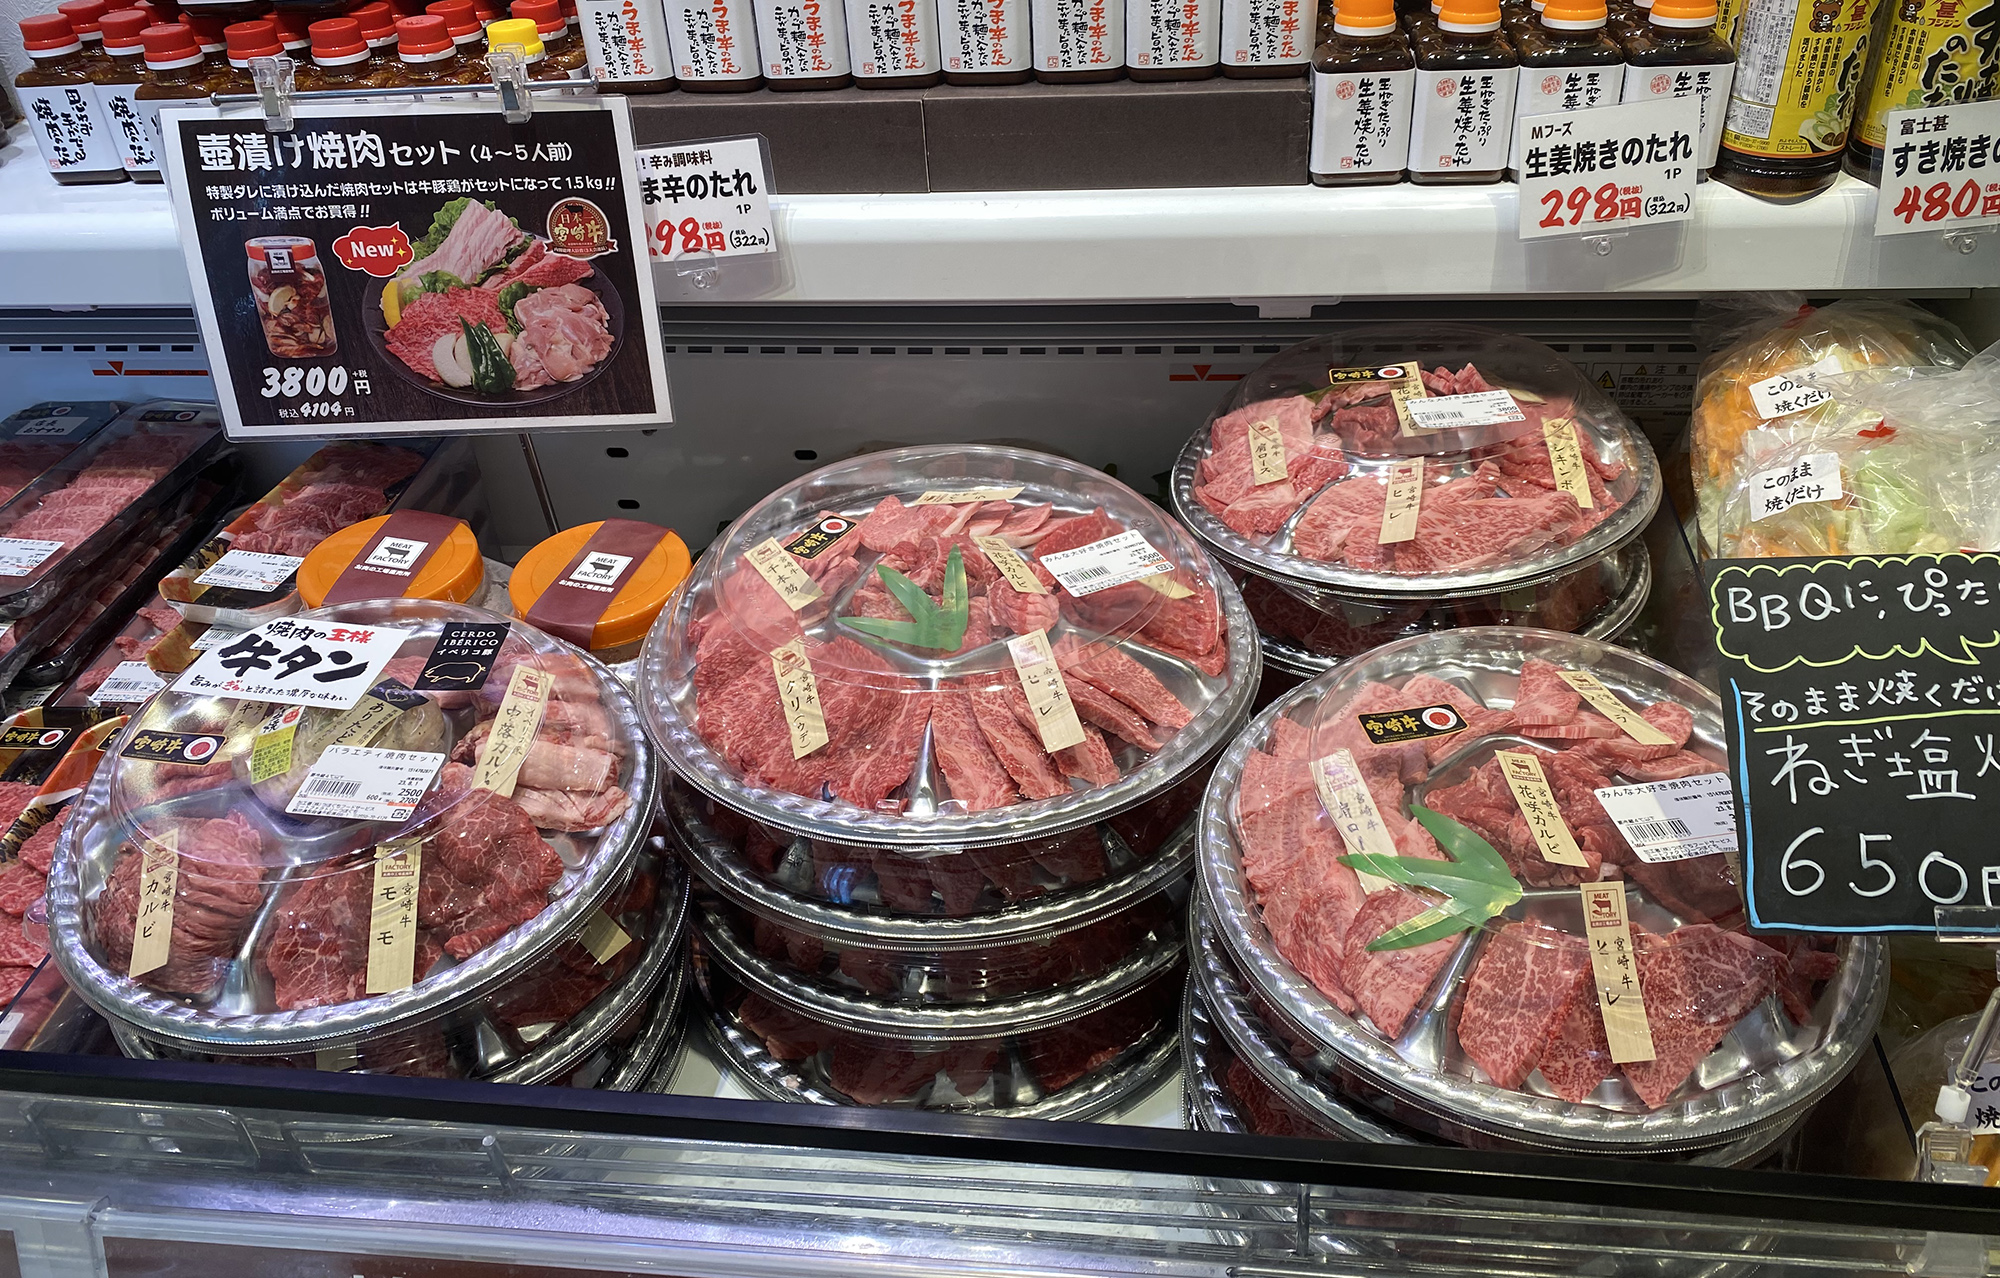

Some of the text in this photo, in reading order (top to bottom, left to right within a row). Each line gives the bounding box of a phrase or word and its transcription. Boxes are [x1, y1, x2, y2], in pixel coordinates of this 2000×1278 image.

[622, 0, 653, 76] うま辛のたれ
[712, 0, 741, 75] うま辛のたれ
[1181, 0, 1203, 62] ま辛のたれ
[1674, 71, 1692, 98] 生
[1354, 78, 1375, 168] 生姜焼のたれ
[1378, 78, 1393, 148] 玉ねぎたっぷり
[1452, 76, 1477, 168] 生姜焼のたれ
[1478, 76, 1495, 146] 玉ねぎたっぷり
[1900, 114, 1950, 136] 富士甚
[1531, 122, 1574, 140] Mフーズ
[636, 150, 713, 170] ！辛み調味料
[1525, 131, 1692, 178] 生姜焼きのたれ
[641, 168, 758, 205] ま辛のたれ
[1664, 168, 1682, 180] 1P
[561, 213, 594, 224] 日本一
[736, 204, 752, 214] 1P
[554, 220, 603, 242] 宮崎牛
[350, 240, 394, 258] New
[1774, 390, 1832, 414] 焼くだけ
[1763, 462, 1813, 490] このまま
[1765, 484, 1824, 513] 焼くだけ
[793, 532, 828, 554] 宮崎牛
[372, 555, 410, 564] FACTORY
[577, 570, 614, 580] FACTORY
[1728, 568, 2000, 631] BBQに、ぴった
[265, 620, 375, 644] 焼肉の王様
[218, 633, 370, 682] 牛タン
[437, 648, 494, 656] イベリコ豚
[334, 702, 384, 746] ありたど
[1366, 714, 1420, 736] 宮崎牛
[134, 735, 184, 754] 宮崎牛
[329, 747, 439, 762] バラエティ焼肉セット
[398, 788, 423, 798] 2500
[1601, 776, 1724, 798] みんな大好き焼肉セット
[1354, 792, 1380, 832] 宮崎牛
[1536, 787, 1558, 820] 宮崎牛
[1518, 784, 1560, 855] 花咲カルビ
[142, 879, 160, 940] カルビ
[377, 886, 398, 946] モモ
[400, 882, 414, 928] 宮崎牛
[1614, 935, 1634, 990] 宮崎牛
